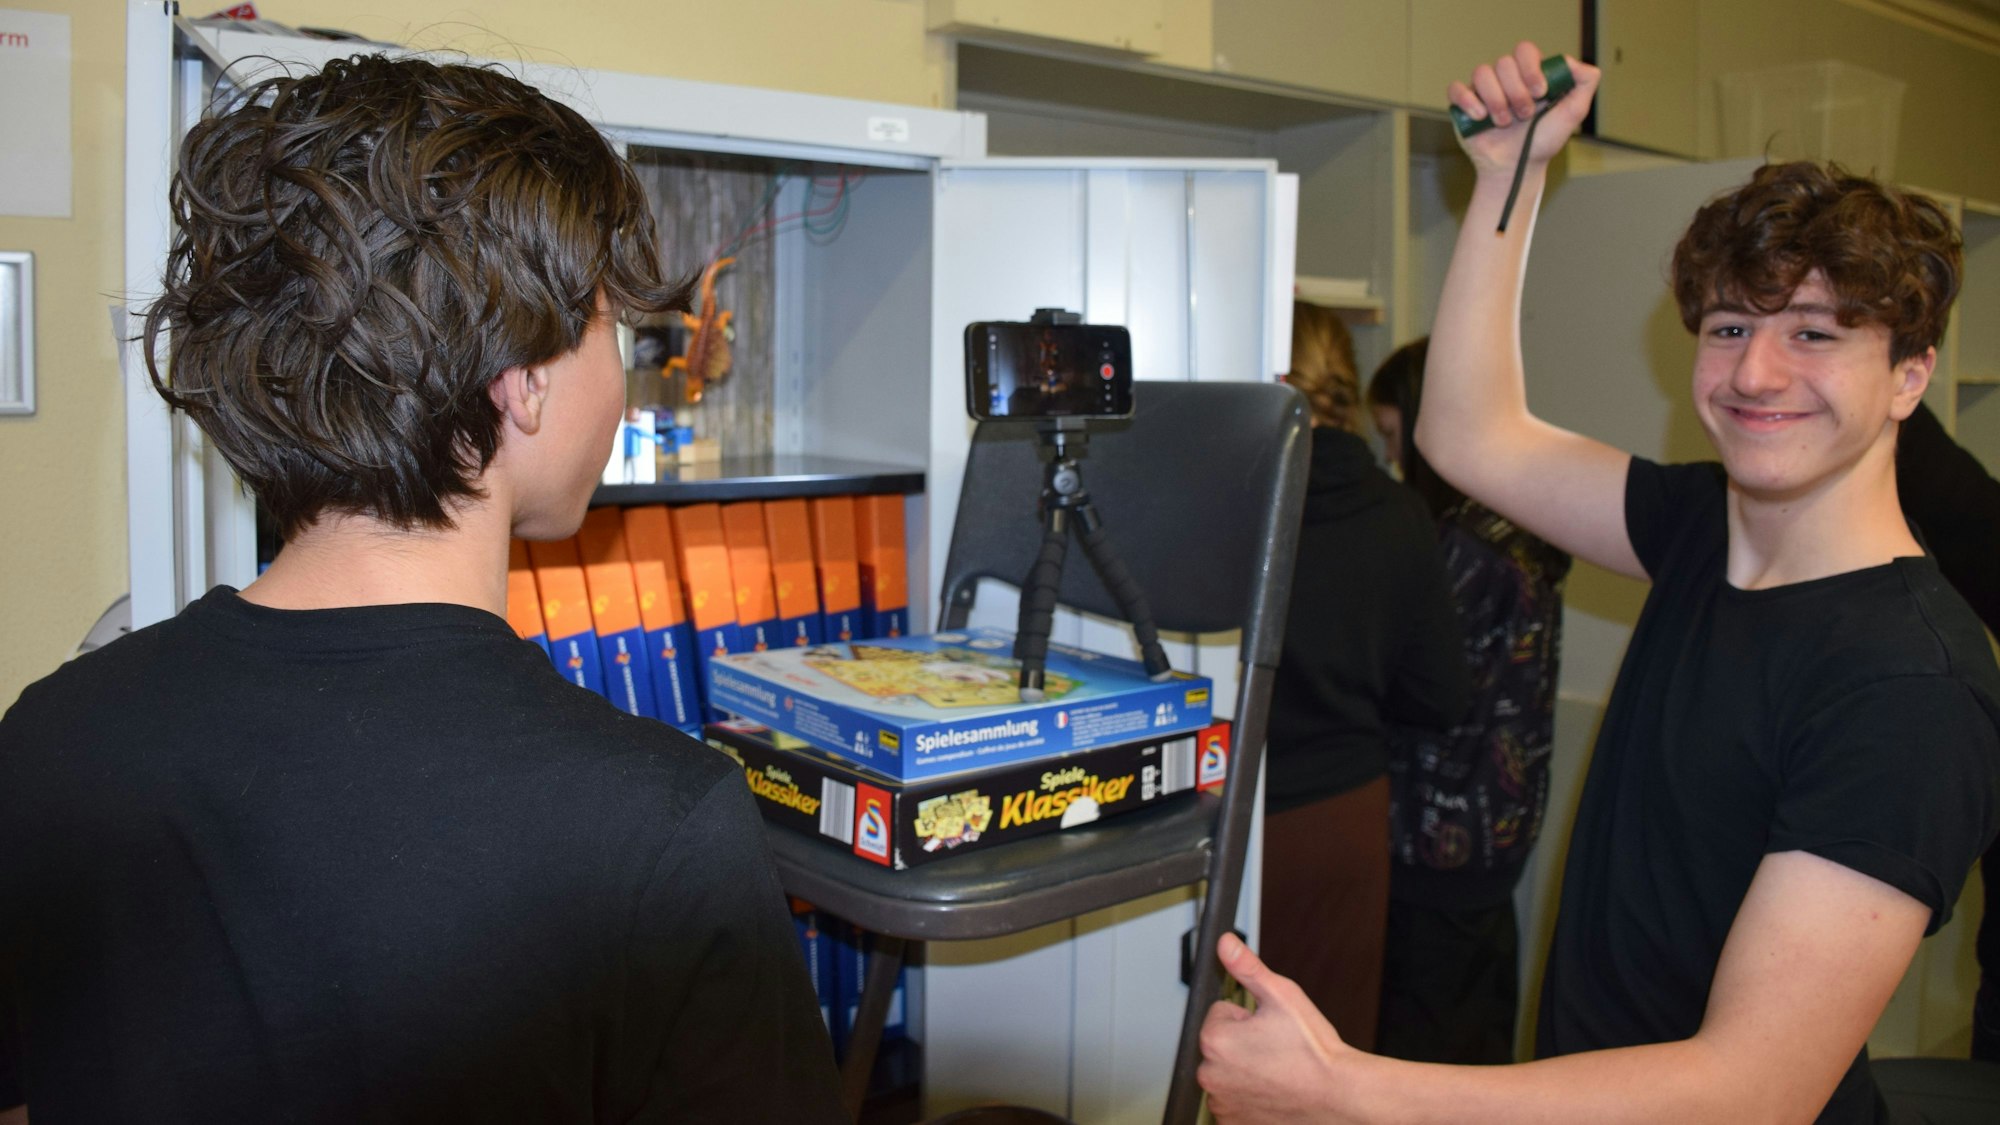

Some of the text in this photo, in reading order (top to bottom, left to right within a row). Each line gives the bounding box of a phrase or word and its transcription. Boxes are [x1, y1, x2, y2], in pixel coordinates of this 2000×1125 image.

[712, 669, 777, 709] Spielesammlung
[915, 719, 1039, 754] Spielesammlung
[766, 764, 792, 784] Spiele
[1040, 766, 1086, 792] Spiele
[745, 768, 821, 816] Klassiker
